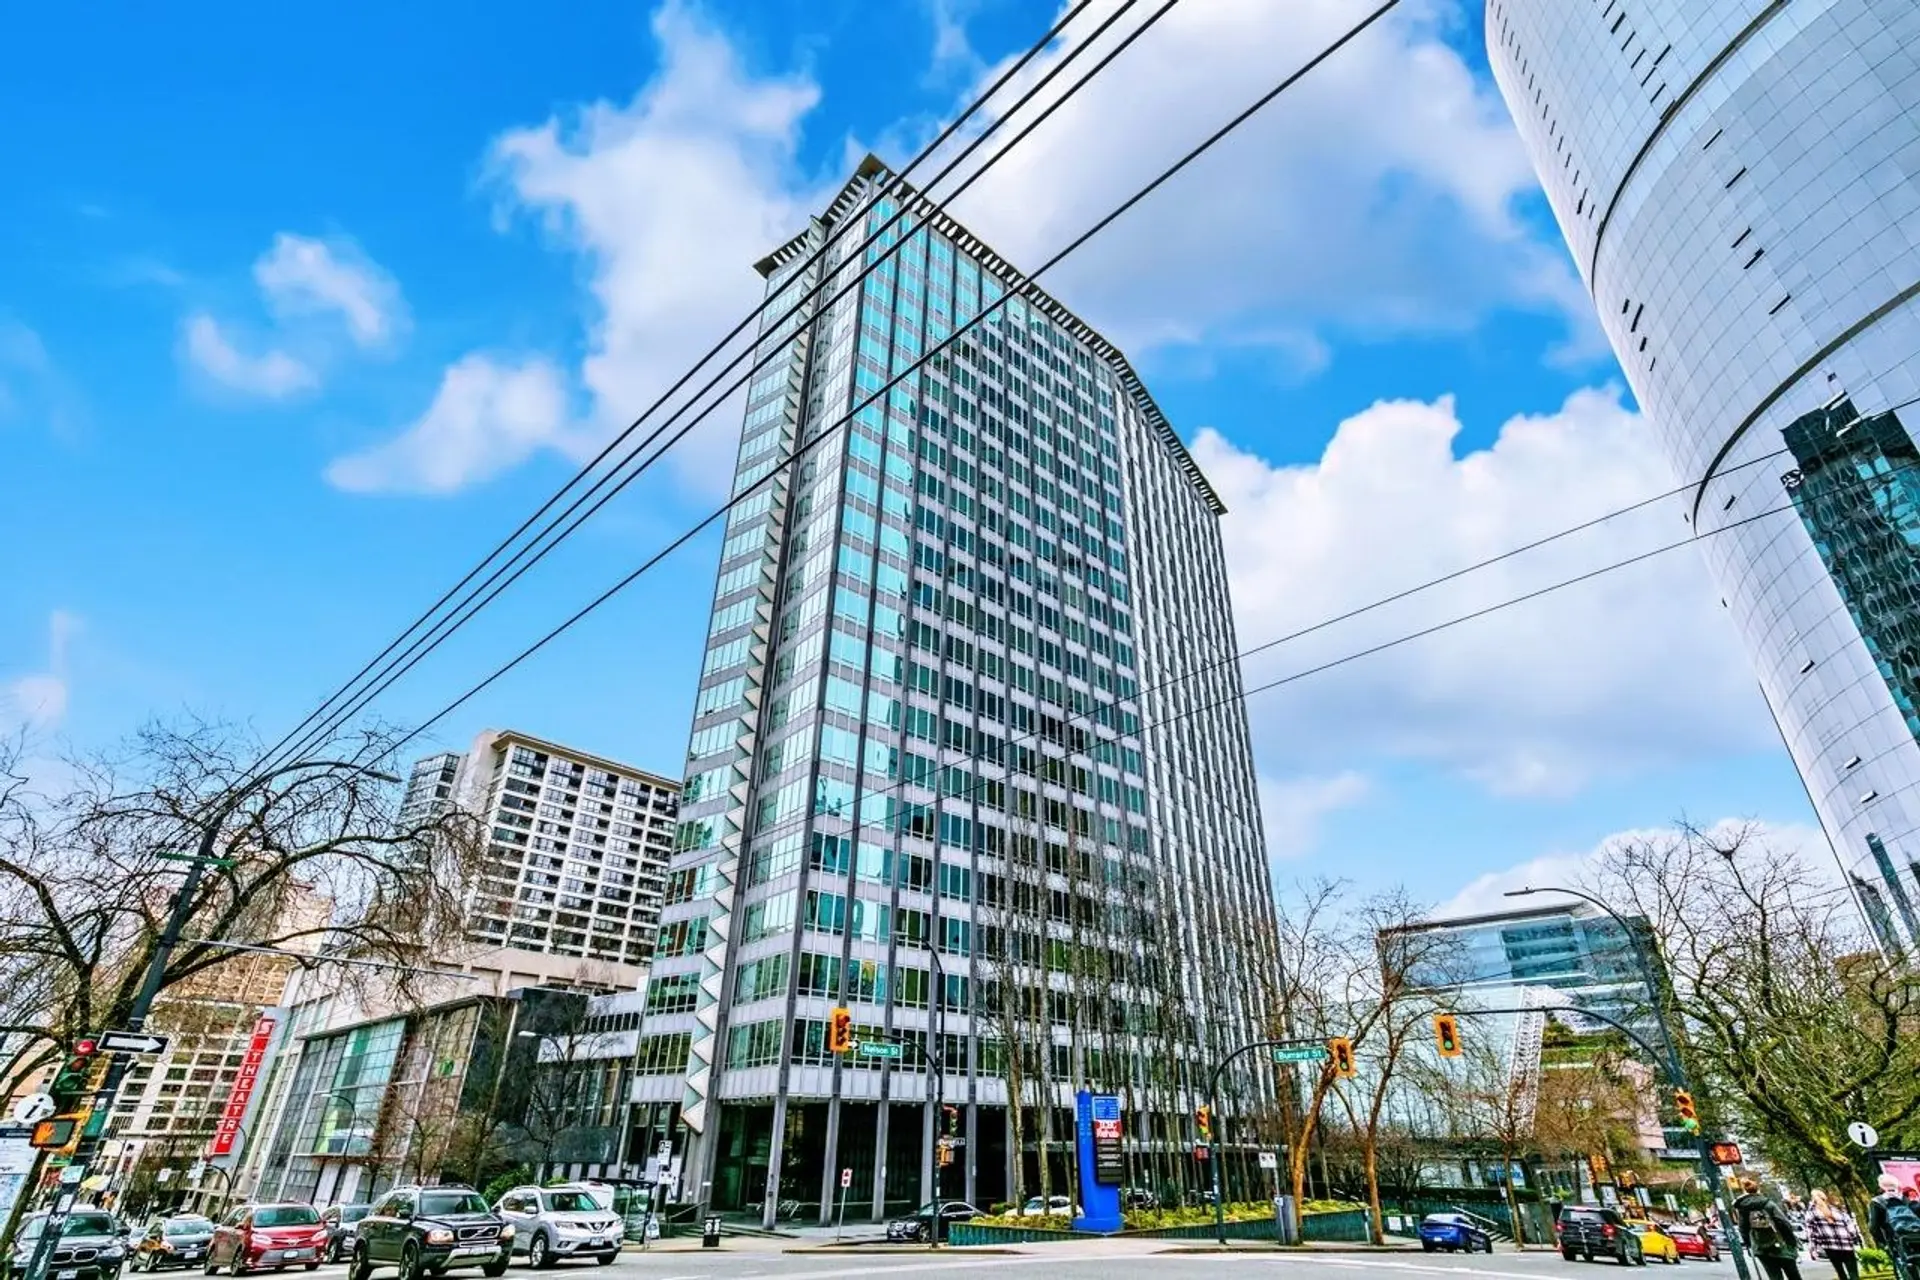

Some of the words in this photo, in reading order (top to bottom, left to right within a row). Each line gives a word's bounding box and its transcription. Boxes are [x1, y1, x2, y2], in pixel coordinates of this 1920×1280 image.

[863, 1044, 889, 1055] Nelson
[890, 1047, 899, 1056] St
[1278, 1050, 1309, 1060] Burrard
[1311, 1050, 1323, 1058] St
[221, 1052, 259, 1144] THEATRE
